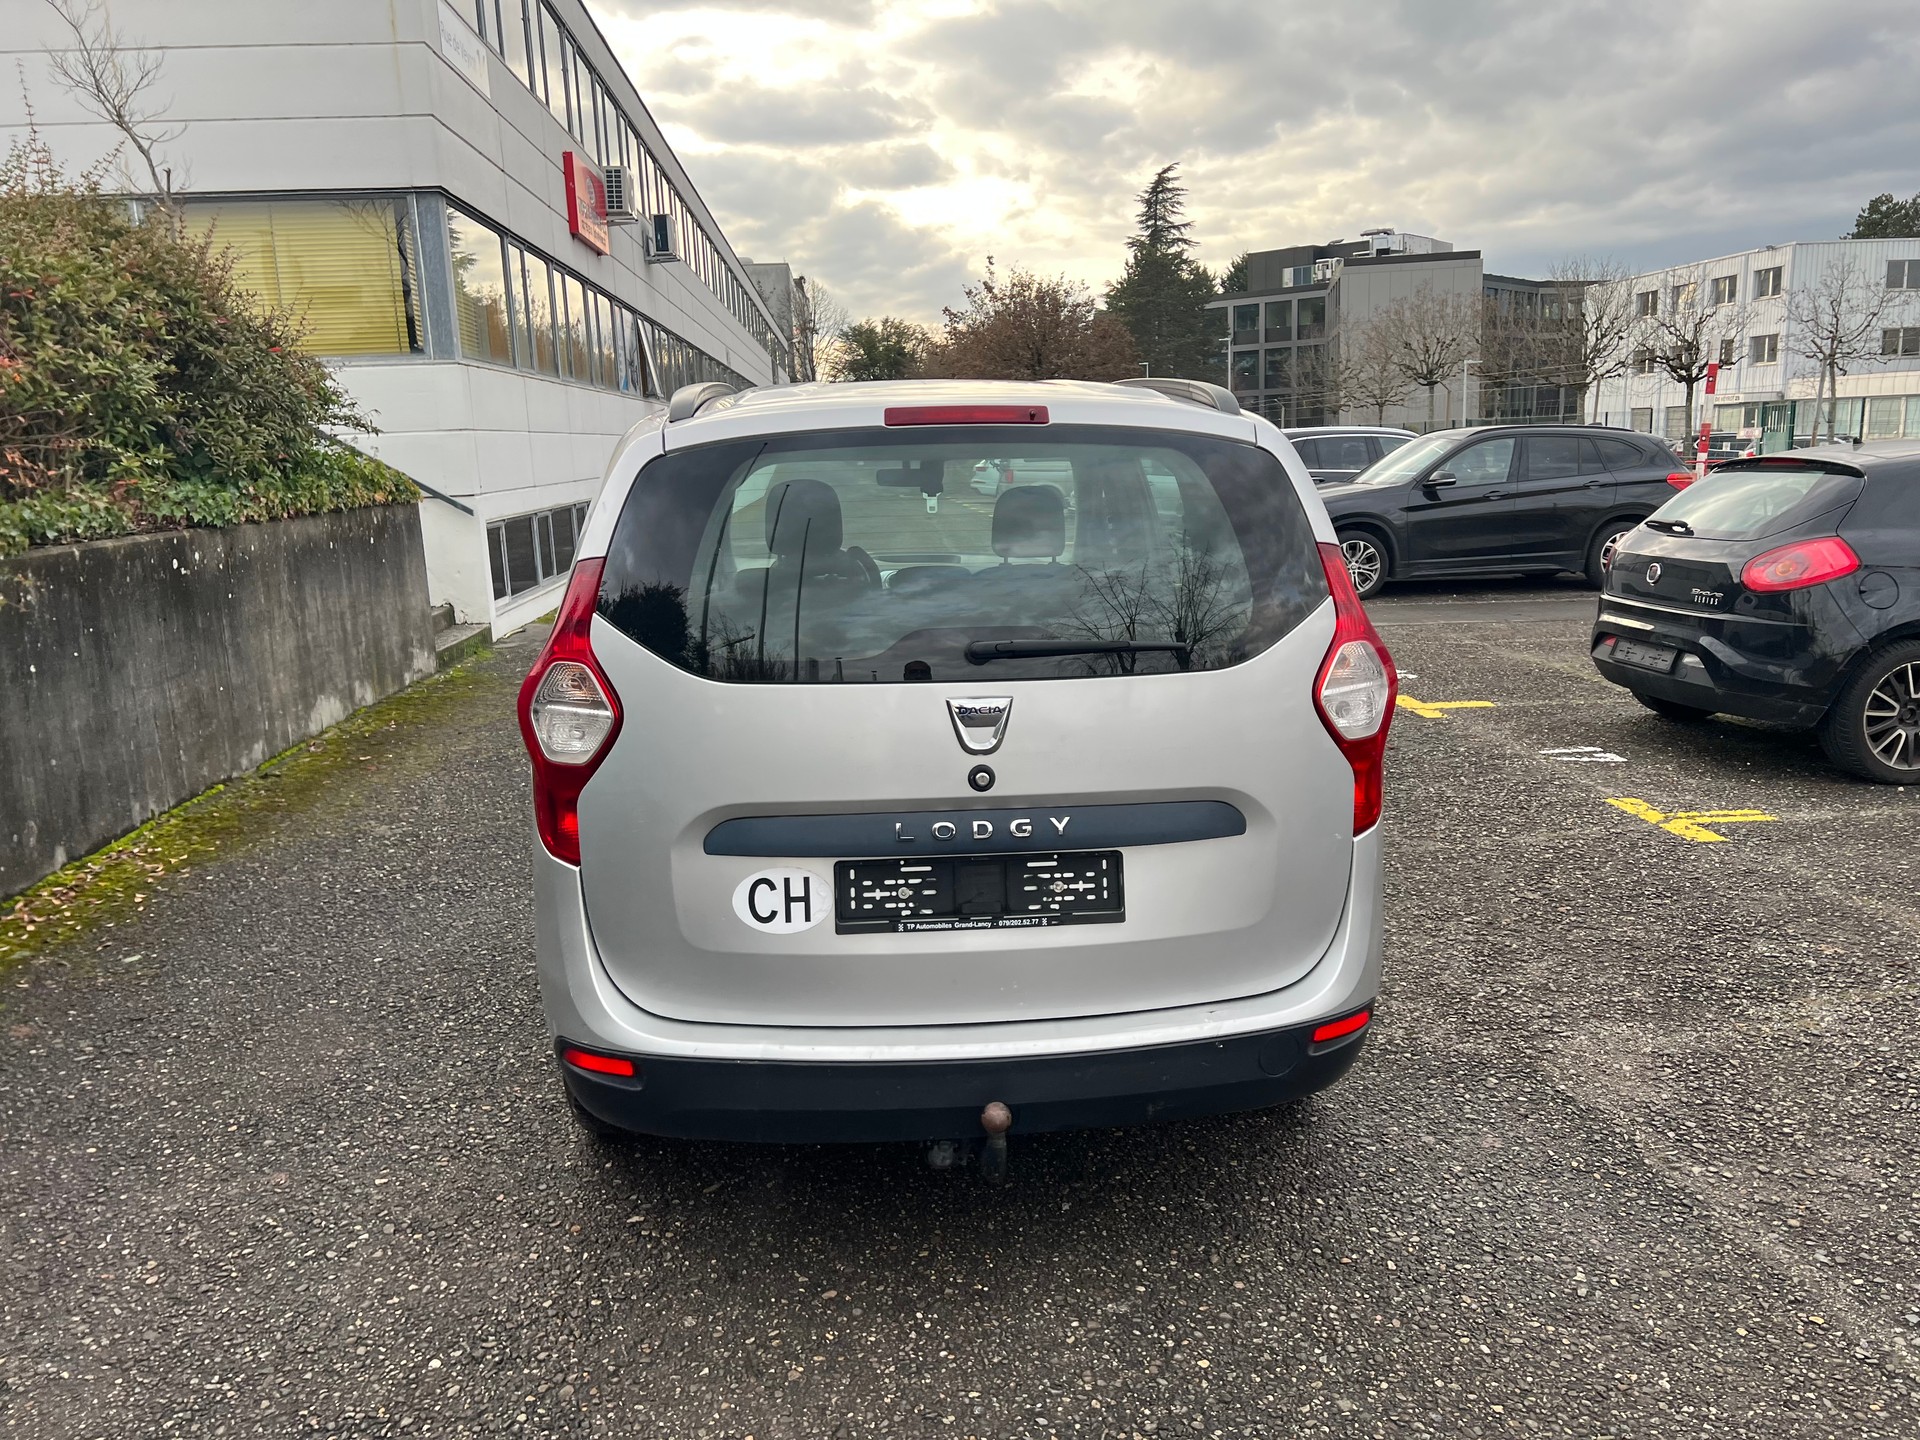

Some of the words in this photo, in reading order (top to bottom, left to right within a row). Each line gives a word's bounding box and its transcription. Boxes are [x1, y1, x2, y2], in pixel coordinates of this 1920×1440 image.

[958, 705, 1003, 715] DACIA
[895, 816, 1071, 842] LODGY
[748, 876, 811, 924] CH
[916, 922, 952, 930] Automobiles
[954, 921, 992, 929] Grand-Lancy
[998, 918, 1039, 926] 079/202.52.77
